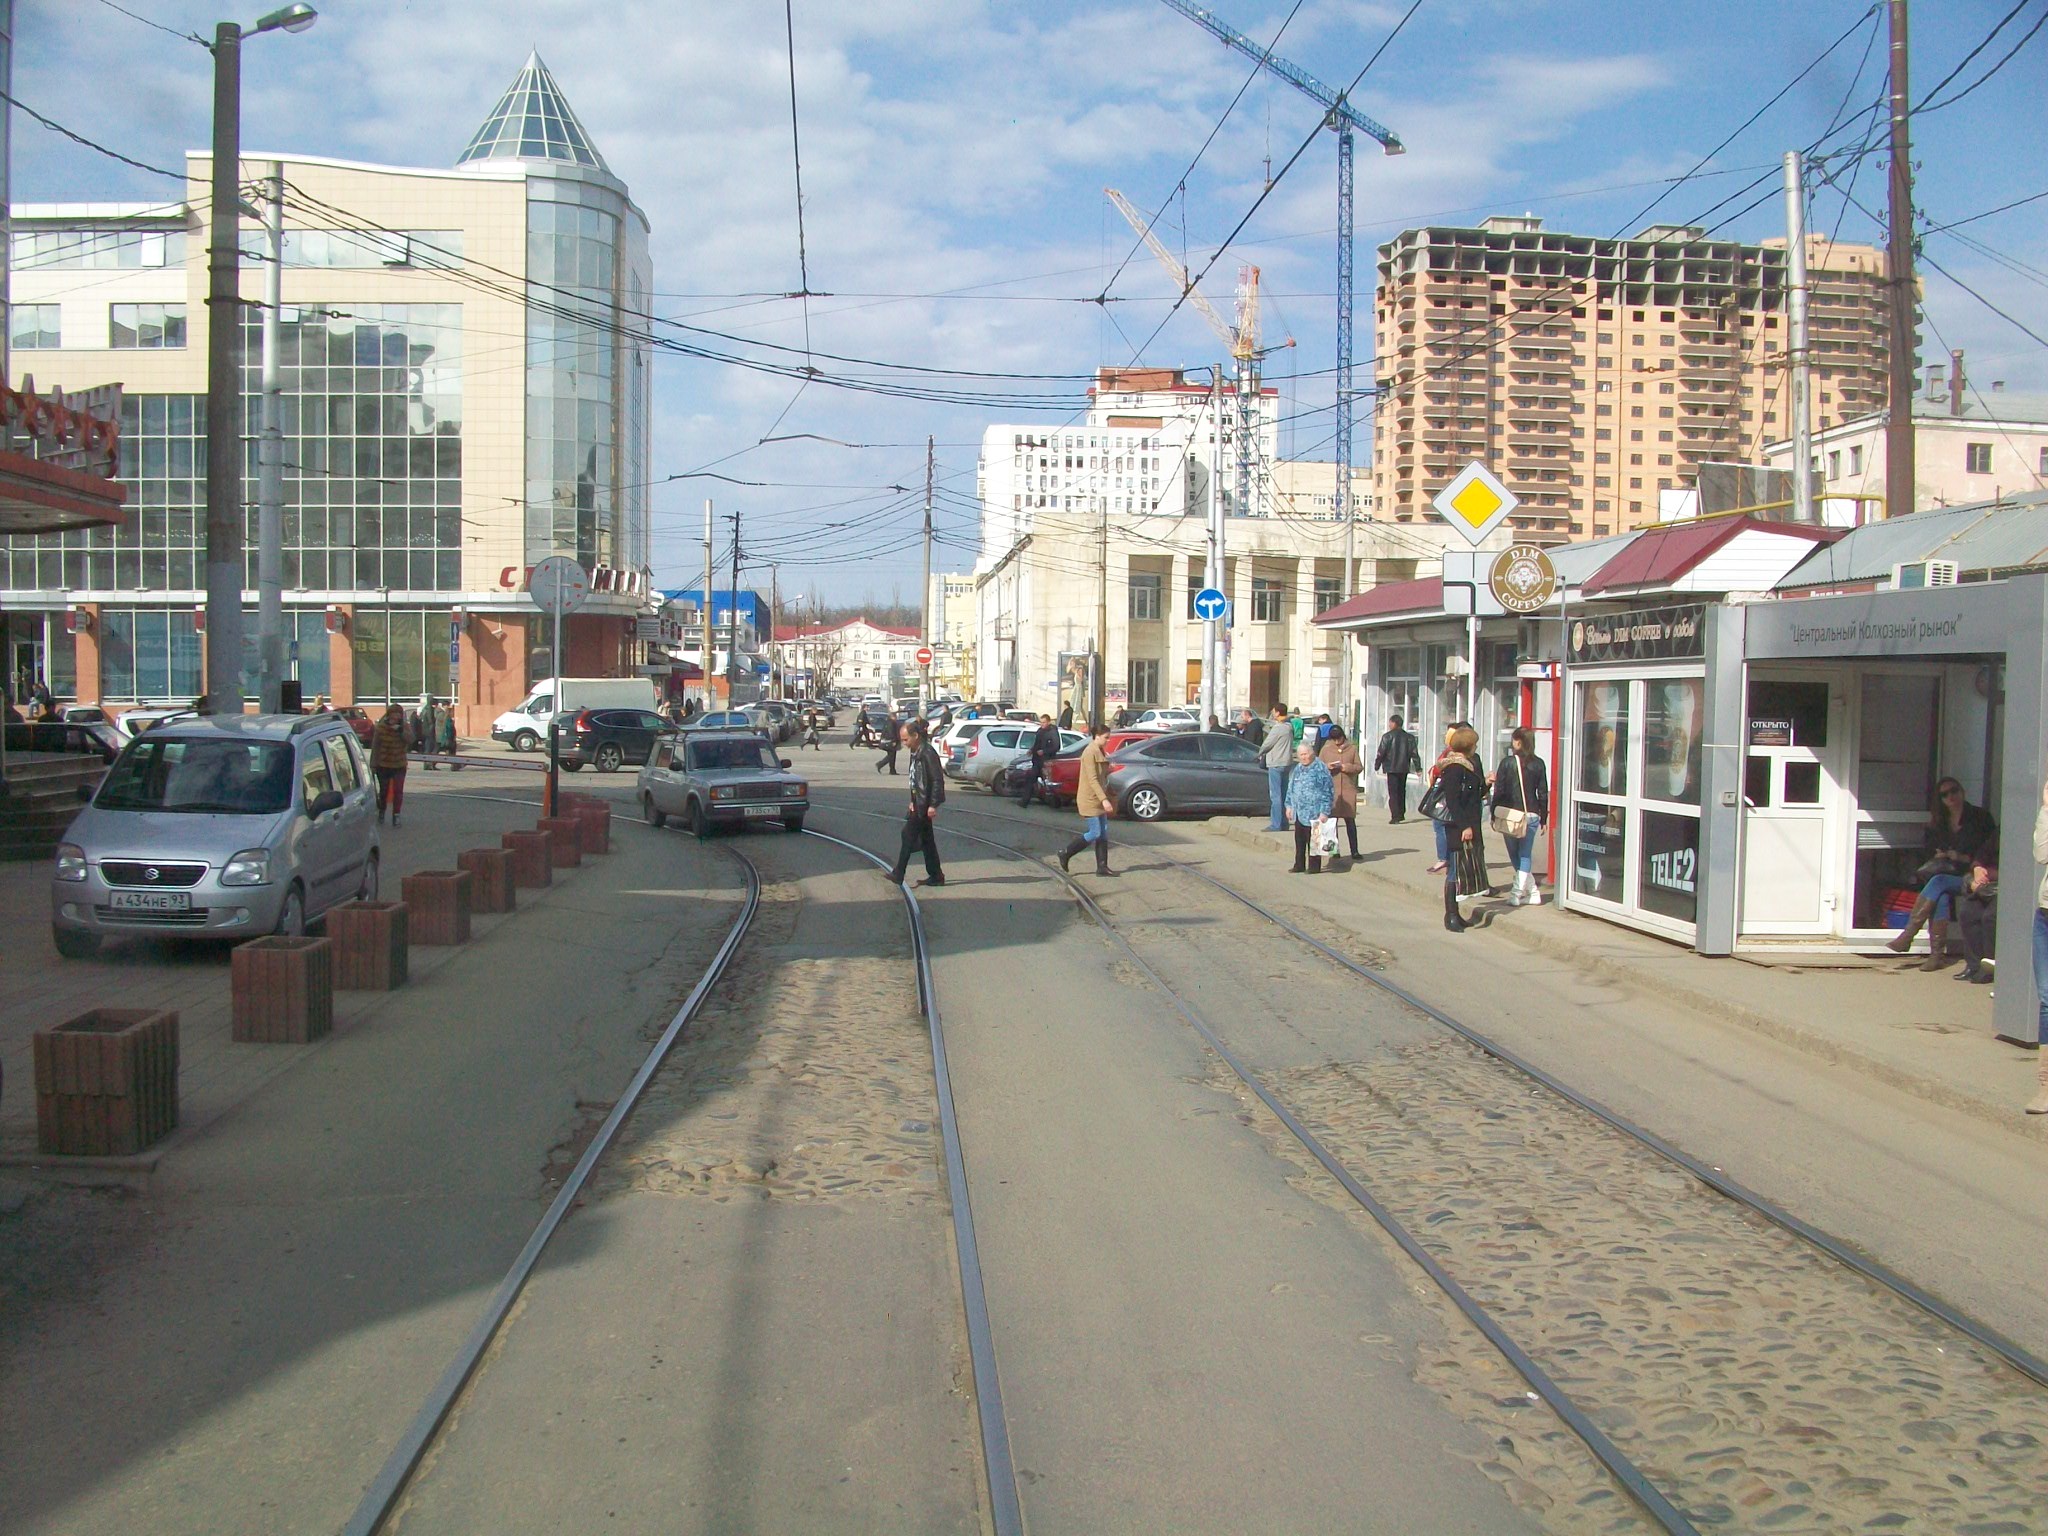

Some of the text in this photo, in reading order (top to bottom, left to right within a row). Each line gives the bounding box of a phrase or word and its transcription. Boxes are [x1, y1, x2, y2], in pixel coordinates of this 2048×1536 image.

[1510, 547, 1541, 560] DIM
[1501, 592, 1546, 609] COFFEE
[1613, 627, 1629, 643] DIM
[1631, 624, 1661, 641] COFFEE
[1858, 617, 1917, 641] Колхозный
[1751, 721, 1790, 729] ОТКРЫТО
[1650, 847, 1696, 893] TELE2
[116, 894, 185, 908] А434НЕ 93
